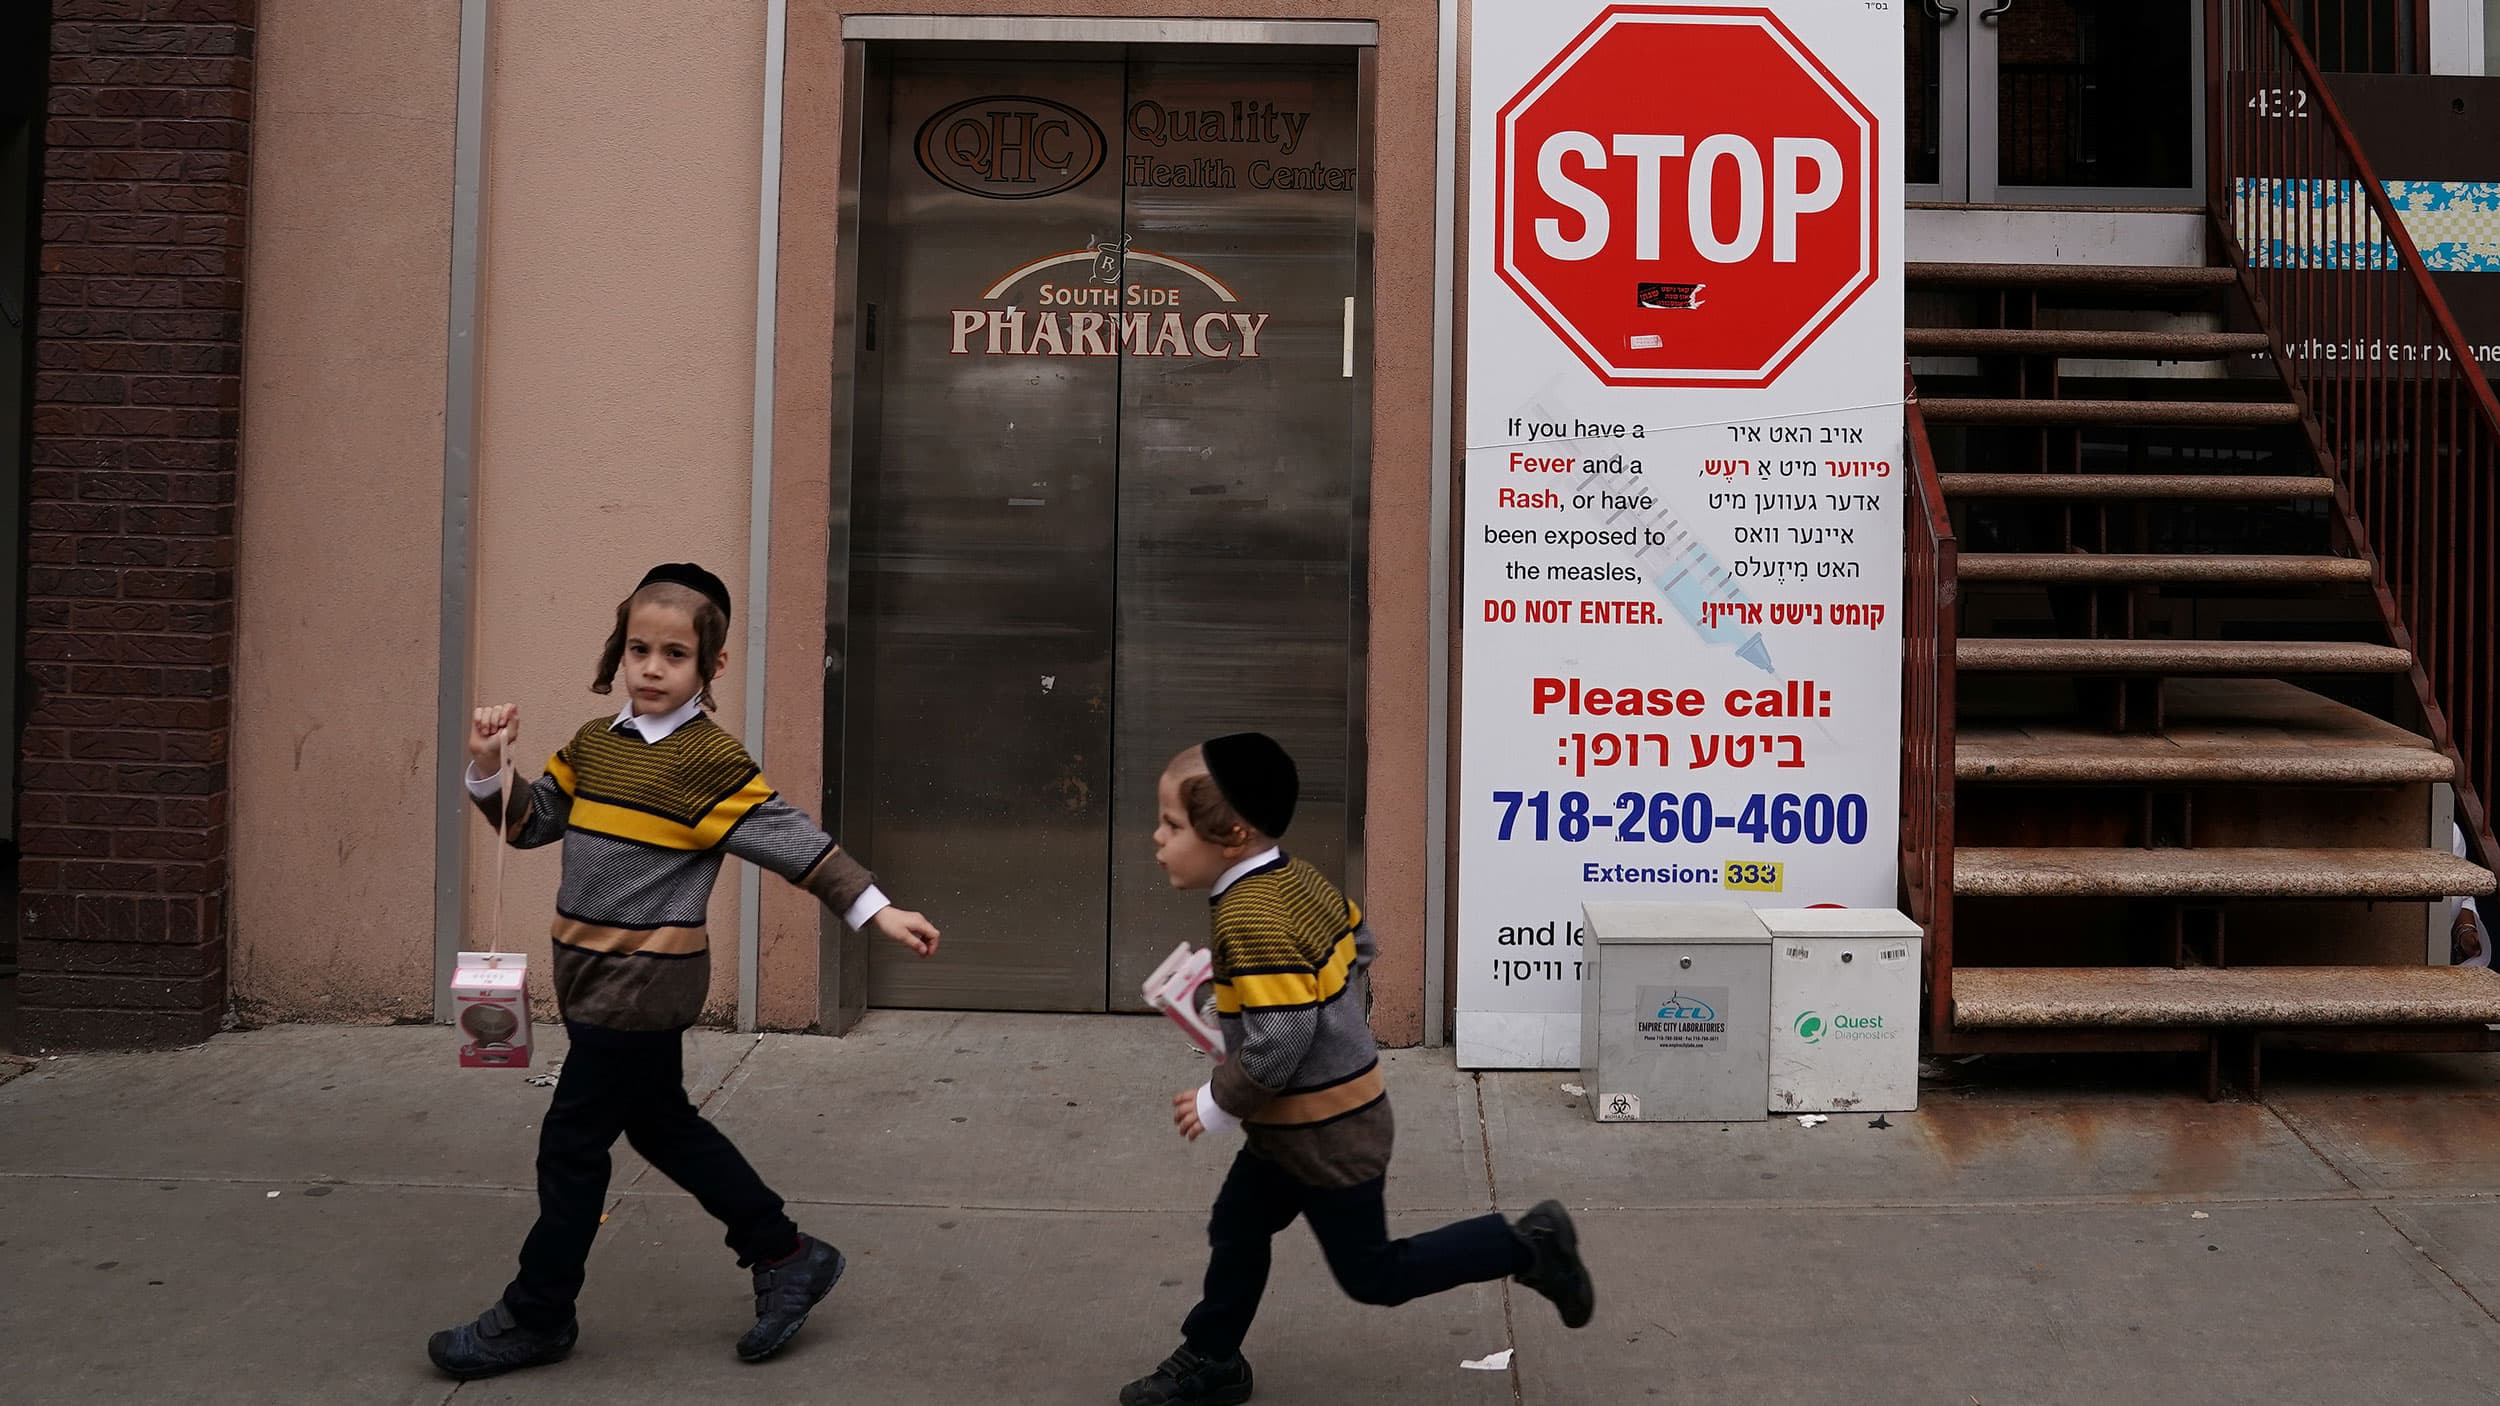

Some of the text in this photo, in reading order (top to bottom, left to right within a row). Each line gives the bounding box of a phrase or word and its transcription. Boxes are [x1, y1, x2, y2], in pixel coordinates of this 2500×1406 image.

[2249, 89, 2308, 117] 432
[1128, 100, 1311, 155] Quality
[945, 112, 1073, 182] QHC
[1126, 155, 1357, 191] Health Center
[1534, 131, 1843, 263] STOP
[950, 309, 1270, 358] PHARMACY
[1508, 418, 1645, 441] If you have a
[1727, 427, 1863, 443] אויב האט איר
[1510, 453, 1643, 474] Fever and a
[1780, 461, 1817, 476] מיט
[1824, 461, 1890, 477] פיווער
[1499, 488, 1652, 512] Rash, or have
[1709, 493, 1880, 514] אדער געווען מיט
[1485, 525, 1666, 549] been exposed to
[1734, 527, 1854, 544] איינער וואס
[1506, 561, 1642, 584] the measles,
[1817, 561, 1859, 578] האט
[1484, 600, 1663, 625] DO NOT ENTER.
[1702, 601, 1885, 630] קומט נישט אריין!
[1532, 677, 1831, 717] Please call:
[1558, 732, 1805, 777] ביטע רופן:
[1492, 791, 1868, 844] 718-260-4600
[1583, 863, 1777, 885] Extension: 333
[1498, 921, 1554, 946] and
[1493, 959, 1562, 986] וויסן!
[1657, 1007, 1706, 1018] ECL
[1834, 1014, 1883, 1028] Quest
[1638, 1022, 1725, 1032] EMPIRE CITY LABORATORIES
[1834, 1030, 1895, 1041] Diagnostics
